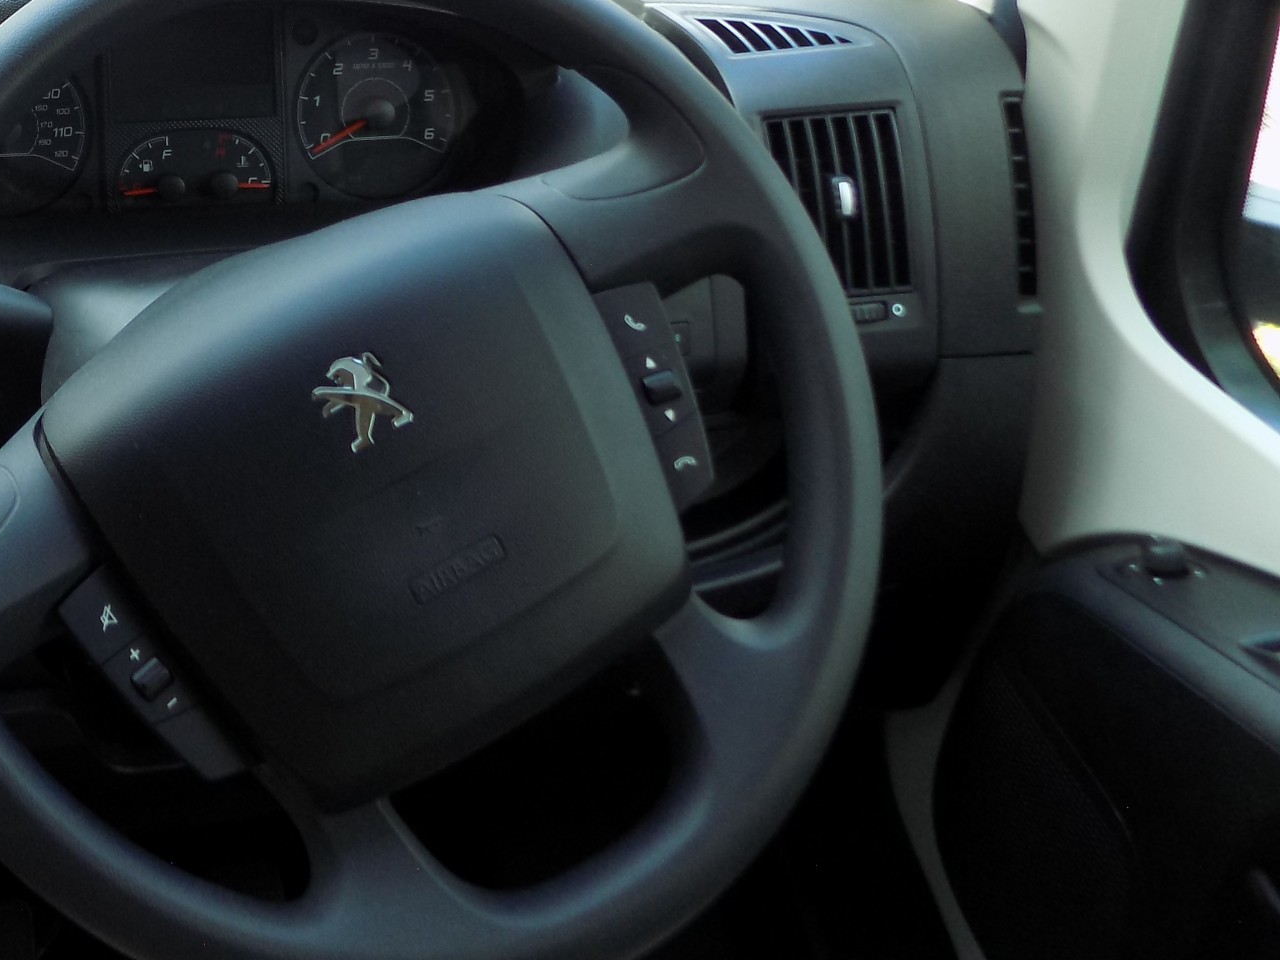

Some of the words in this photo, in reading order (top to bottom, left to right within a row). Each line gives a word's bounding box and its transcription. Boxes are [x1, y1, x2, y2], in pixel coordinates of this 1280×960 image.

[368, 48, 379, 60] 3
[333, 63, 344, 75] 2
[402, 59, 412, 71] 4
[313, 95, 321, 107] 1
[424, 90, 435, 102] 5
[53, 126, 73, 137] 110
[424, 128, 435, 139] 6
[162, 149, 173, 159] F
